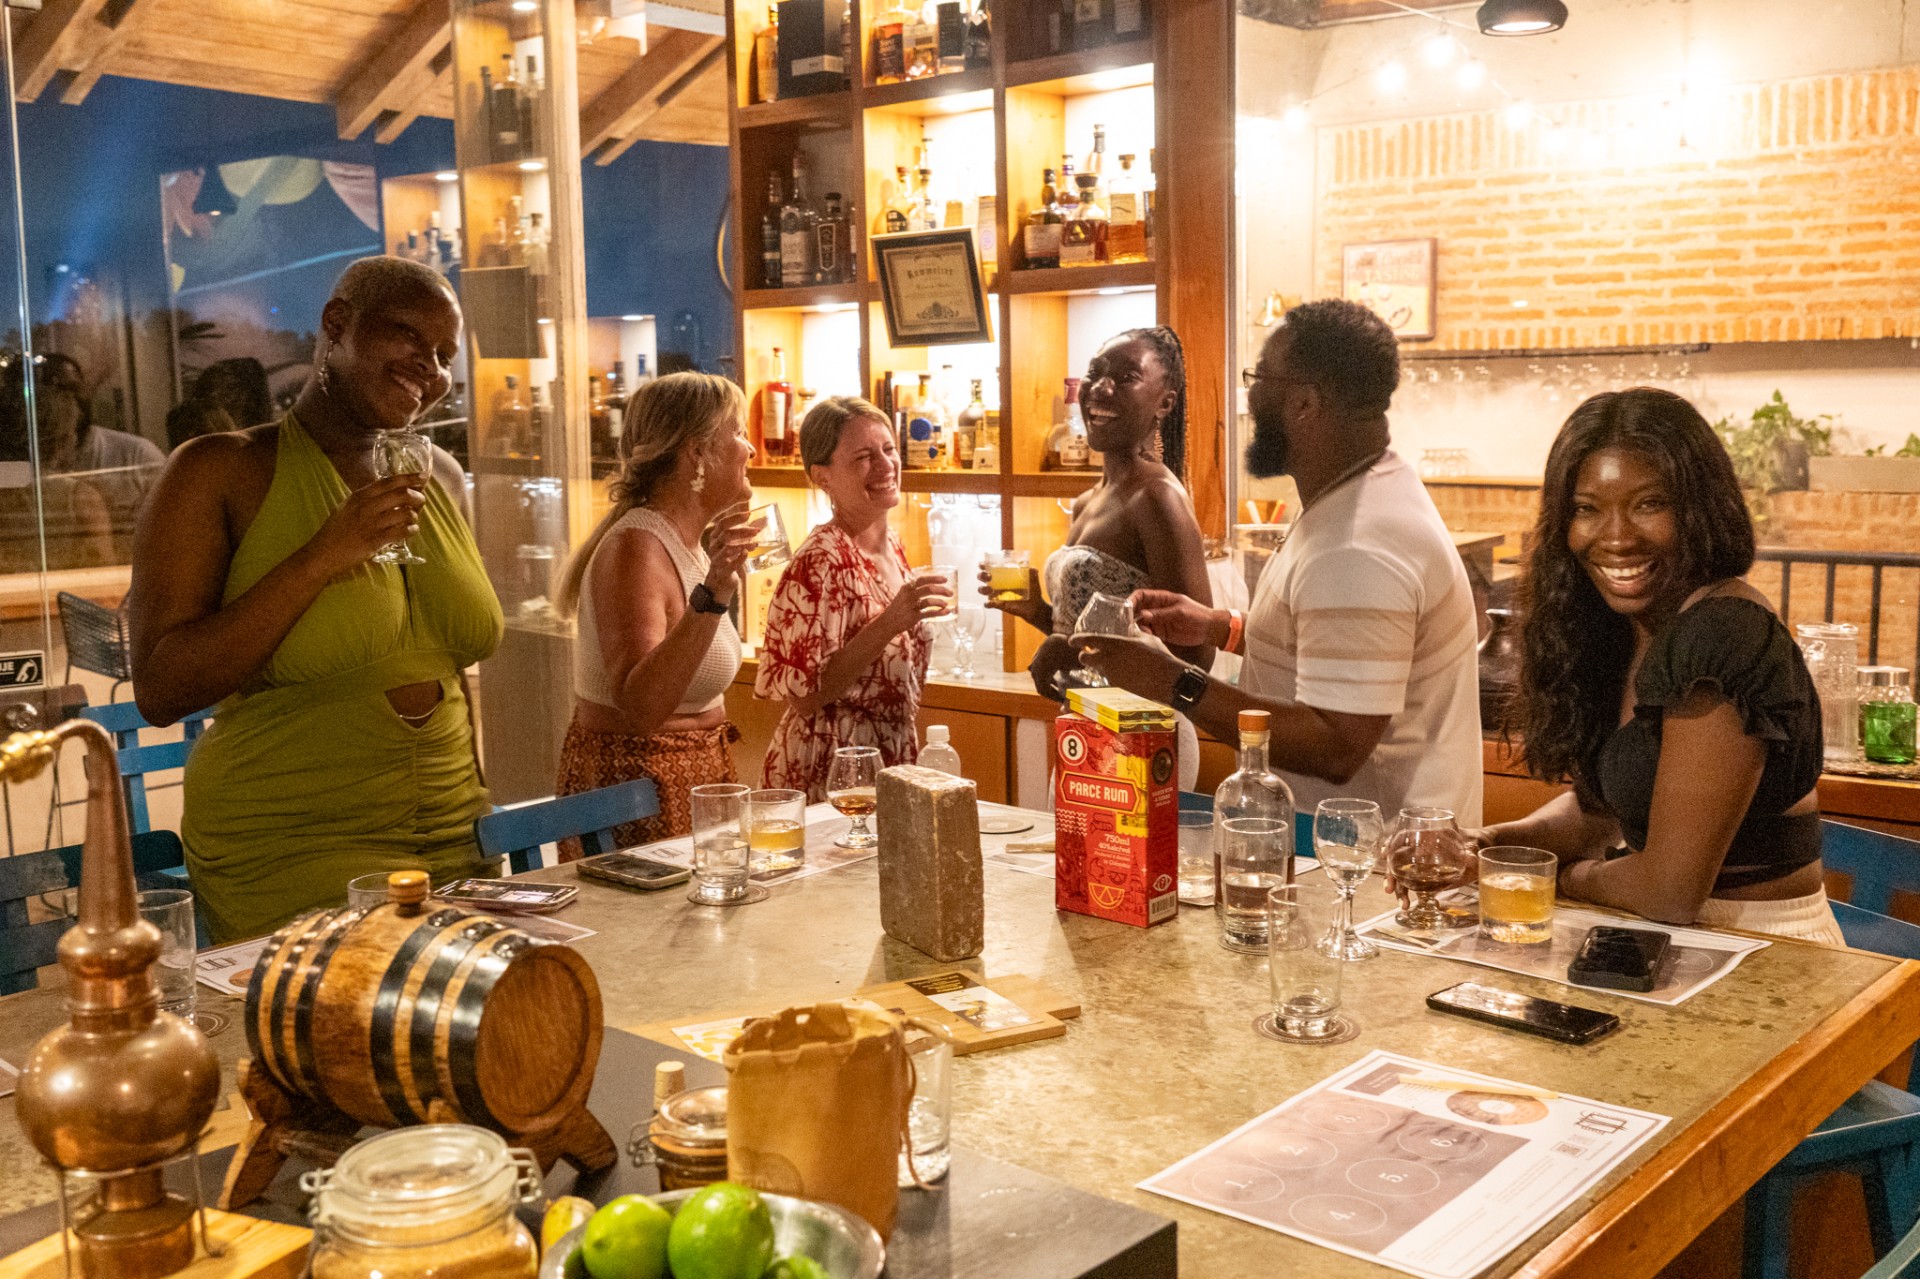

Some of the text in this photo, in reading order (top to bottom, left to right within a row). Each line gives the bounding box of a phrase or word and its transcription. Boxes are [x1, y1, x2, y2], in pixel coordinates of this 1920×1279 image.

[0, 661, 15, 672] JE
[1068, 738, 1077, 757] 8
[1069, 781, 1129, 804] PARCE RUM
[1104, 833, 1130, 846] 750ml
[1429, 1138, 1457, 1147] 6.
[1280, 1145, 1308, 1156] 2.
[1378, 1172, 1409, 1183] 5.
[1328, 1210, 1356, 1220] 4.
